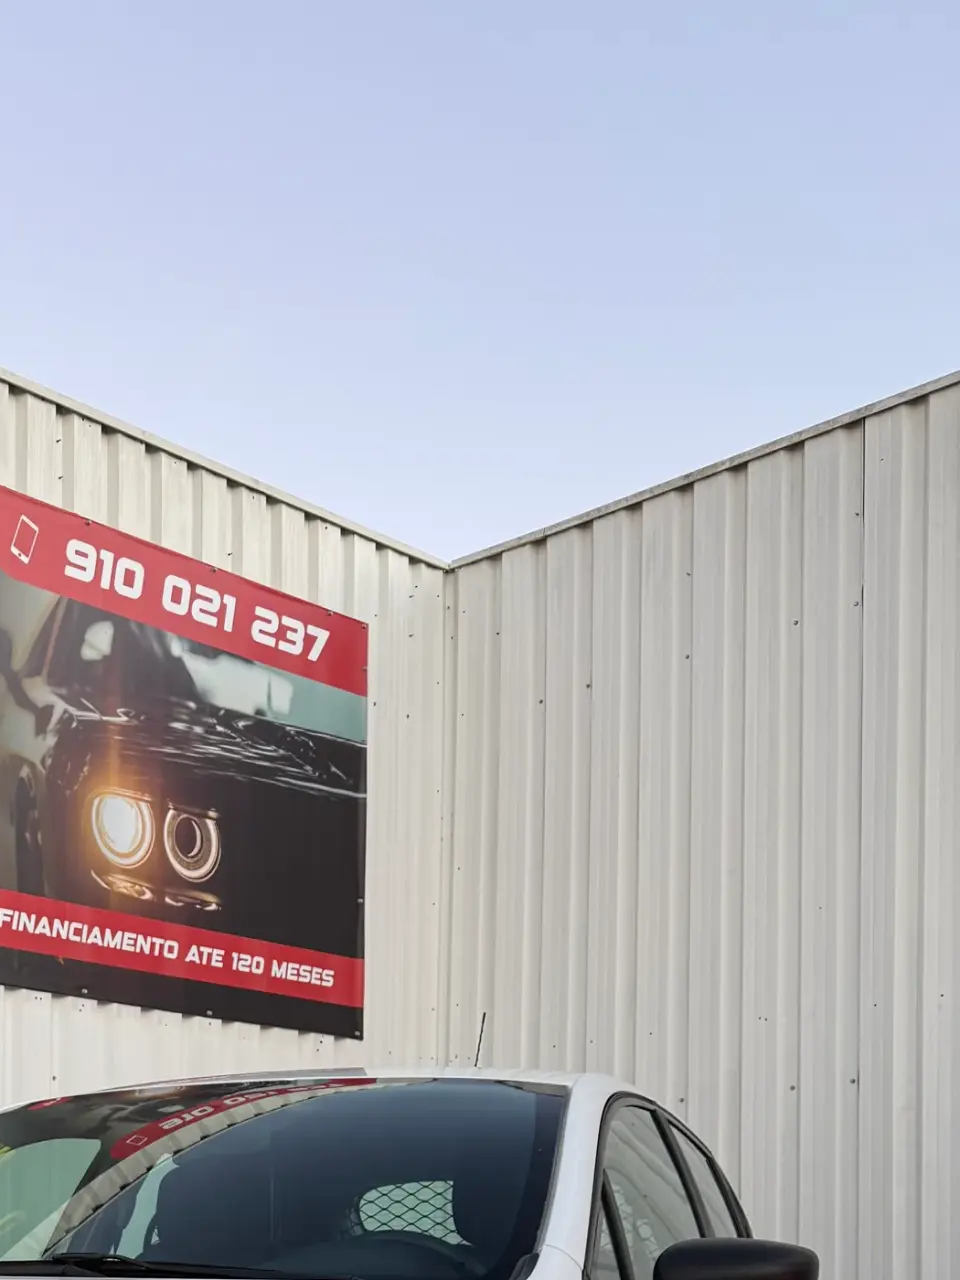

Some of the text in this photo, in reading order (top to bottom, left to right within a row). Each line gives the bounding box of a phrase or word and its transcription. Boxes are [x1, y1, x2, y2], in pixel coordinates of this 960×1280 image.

[64, 538, 330, 663] 910 021 237
[185, 945, 224, 969] ATE
[231, 952, 265, 976] 120
[271, 960, 335, 988] MESES
